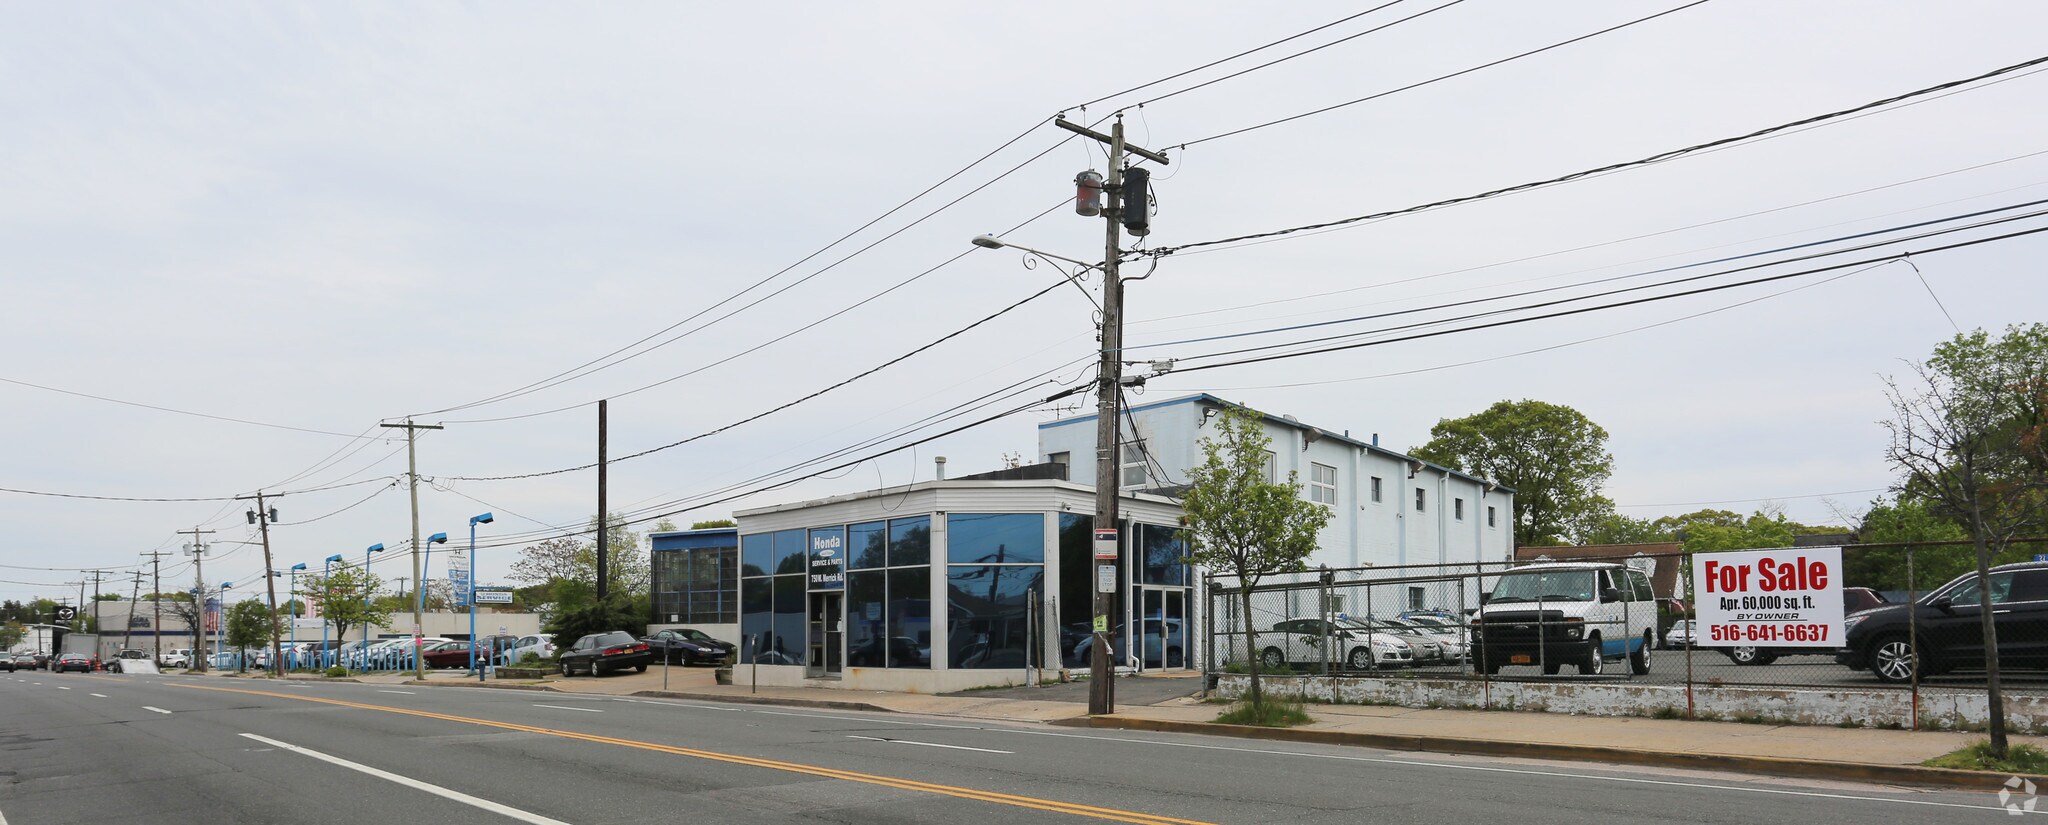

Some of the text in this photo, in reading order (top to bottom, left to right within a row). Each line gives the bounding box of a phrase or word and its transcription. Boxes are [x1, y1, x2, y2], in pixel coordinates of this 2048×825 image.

[814, 536, 840, 549] Honda
[823, 573, 837, 582] Merrick
[1705, 556, 1828, 593] For Sale
[1720, 595, 1816, 611] Apr. 60,000 sq. ft.
[1754, 612, 1800, 620] OWNER
[1711, 624, 1829, 642] 516-641-6637
